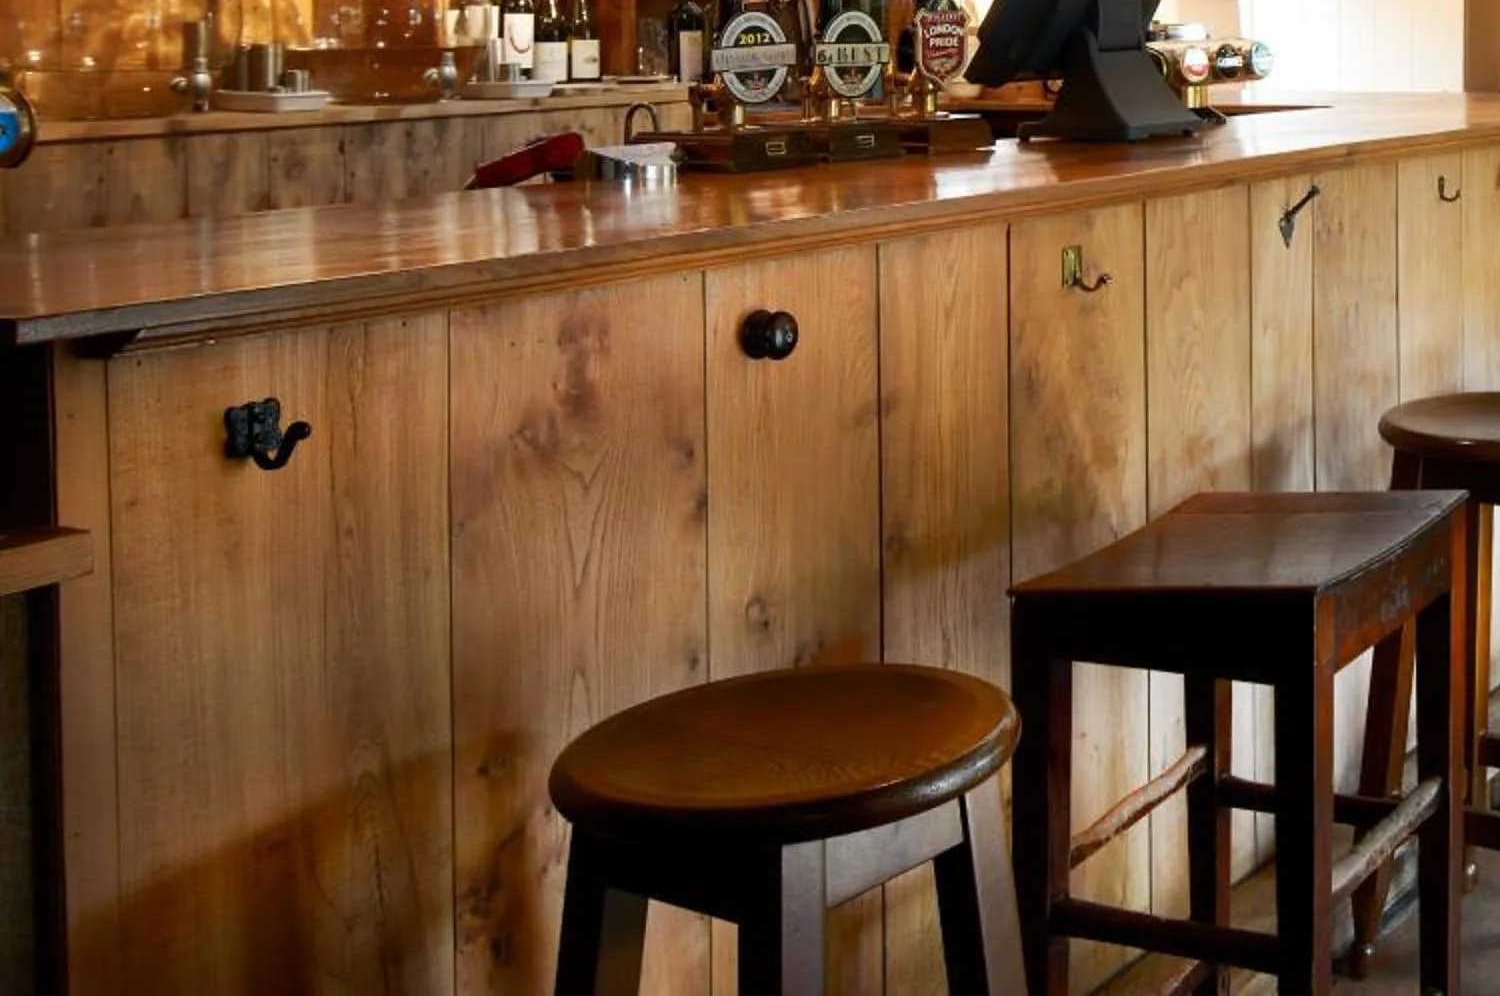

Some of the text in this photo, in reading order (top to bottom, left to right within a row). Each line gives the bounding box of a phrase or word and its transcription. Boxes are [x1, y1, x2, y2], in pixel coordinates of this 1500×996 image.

[924, 23, 964, 38] LONDON
[739, 33, 770, 45] 2012
[929, 36, 959, 48] PRIDE
[837, 46, 884, 62] BEST
